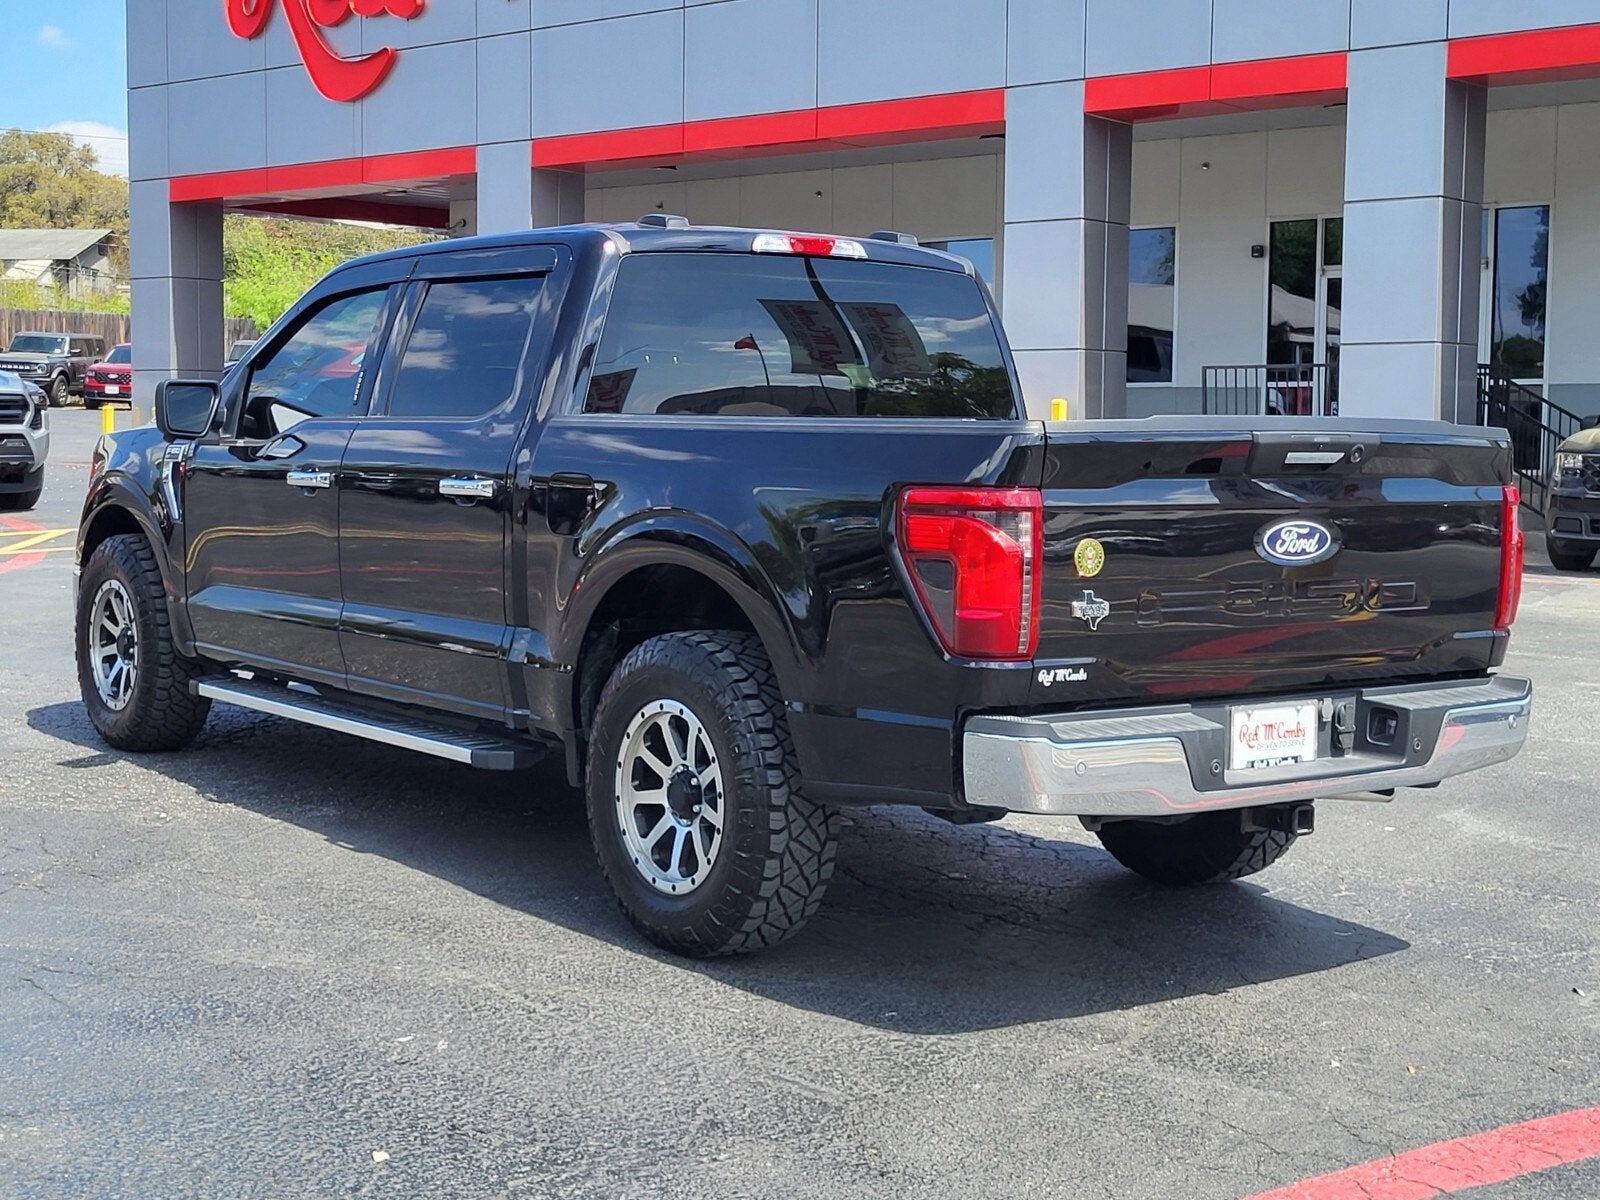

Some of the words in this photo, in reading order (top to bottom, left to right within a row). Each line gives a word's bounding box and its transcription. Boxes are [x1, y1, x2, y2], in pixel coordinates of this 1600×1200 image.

[1275, 526, 1320, 554] Ford
[1239, 724, 1260, 749] Red
[1262, 721, 1306, 741] McCombs
